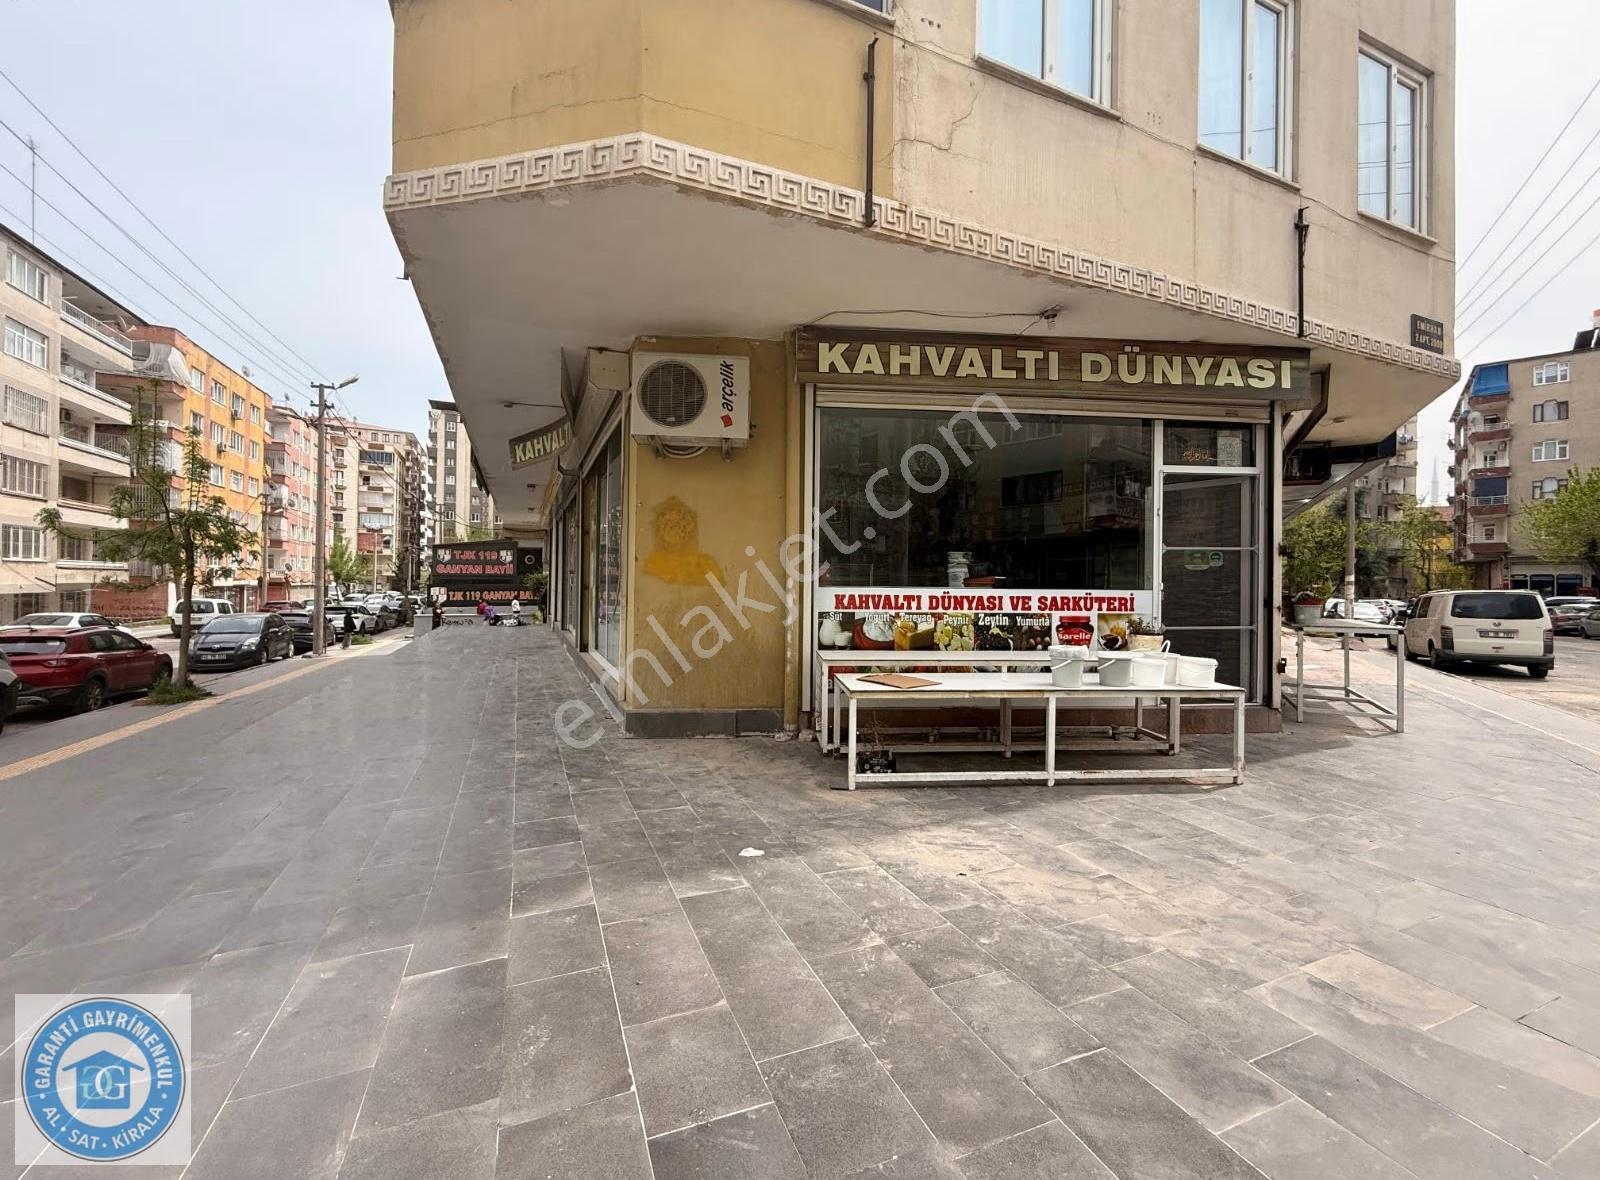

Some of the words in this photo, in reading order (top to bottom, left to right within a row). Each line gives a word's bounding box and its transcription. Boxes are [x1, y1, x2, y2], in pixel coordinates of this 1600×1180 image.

[817, 342, 1060, 381] KAHVALTI
[1080, 345, 1292, 389] DÜNYASI
[720, 360, 737, 412] arçelik
[453, 550, 476, 560] TJK
[436, 564, 483, 574] GANYAN
[448, 591, 464, 601] TJK
[465, 591, 480, 600] 119
[834, 593, 922, 611] KAHVALTI
[928, 591, 1004, 611] DÜNYASI
[1009, 595, 1032, 611] VE
[1040, 592, 1136, 612] SARKÜTERİ
[943, 615, 969, 628] Peynir
[978, 613, 1010, 629] Zeytin
[1016, 615, 1050, 627] Yumurta
